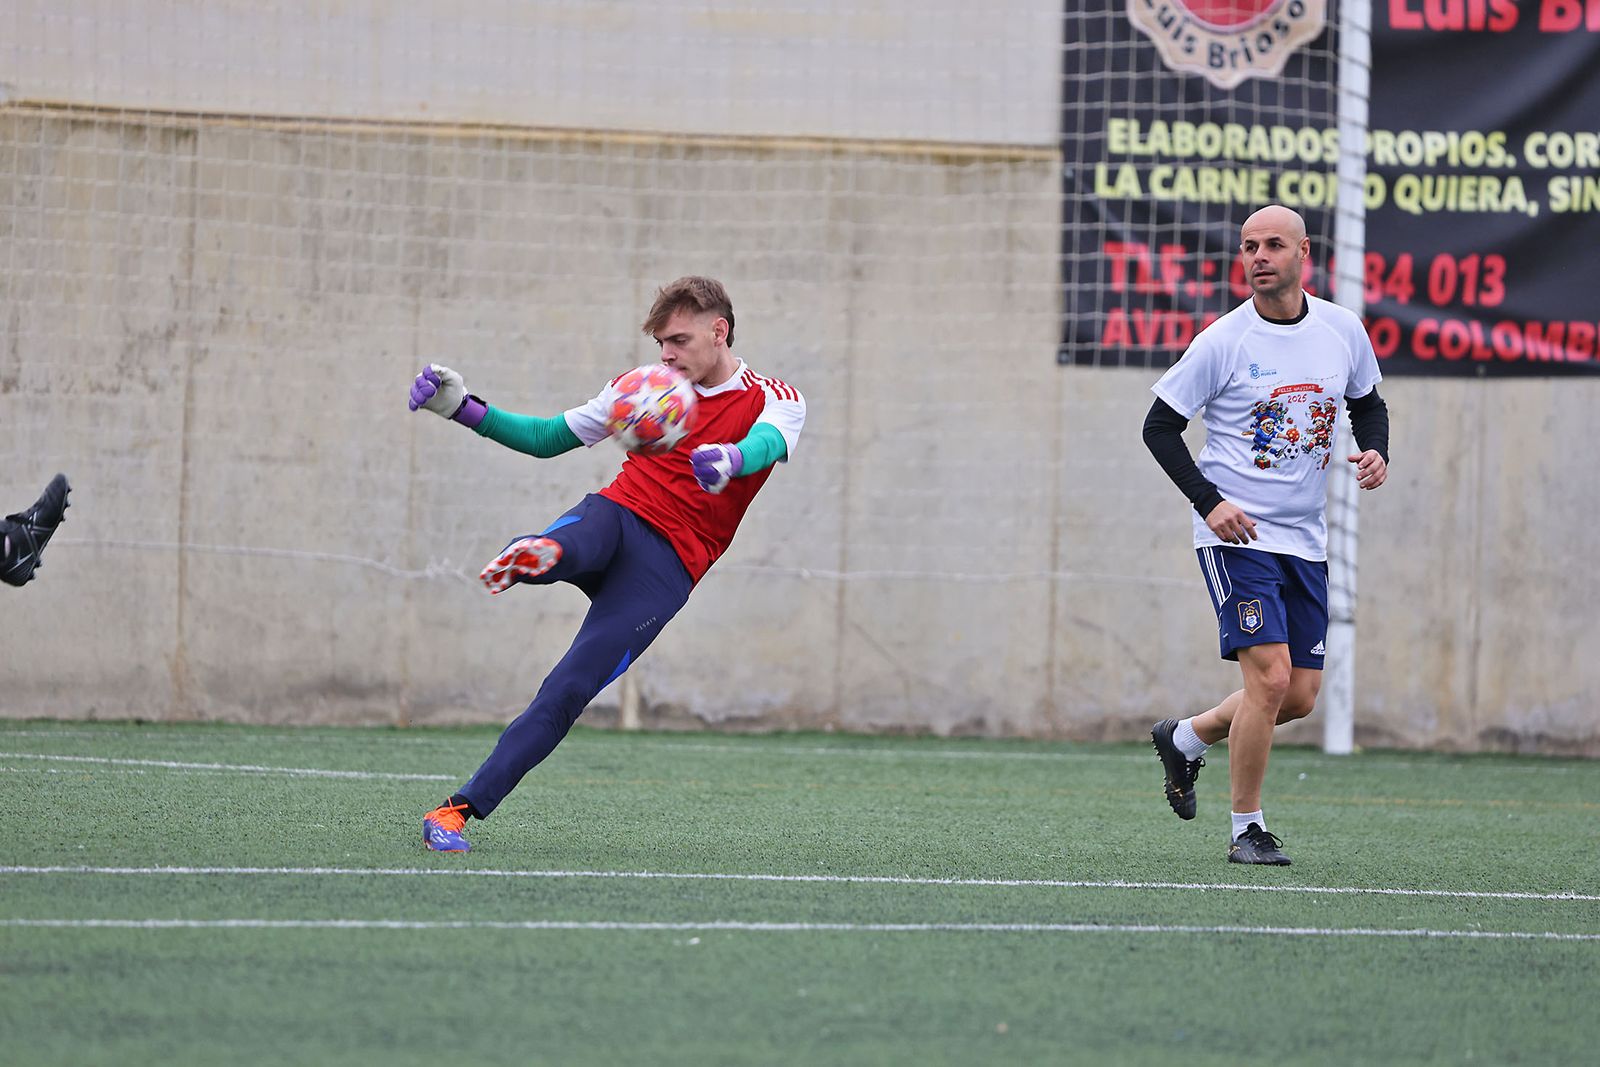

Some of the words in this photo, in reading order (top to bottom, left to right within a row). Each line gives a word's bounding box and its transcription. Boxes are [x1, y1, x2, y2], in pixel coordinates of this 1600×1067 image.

[1144, 0, 1198, 54] uis
[1207, 0, 1306, 68] Brioso
[1107, 117, 1341, 164] ELABORADOS
[1523, 131, 1600, 169] COR
[1094, 162, 1143, 200] LA
[1150, 165, 1270, 206] CARNE
[1393, 173, 1539, 217] QUIERA,
[1427, 253, 1507, 307] 013
[1411, 317, 1600, 362] COLOMB
[1287, 394, 1307, 403] 2025
